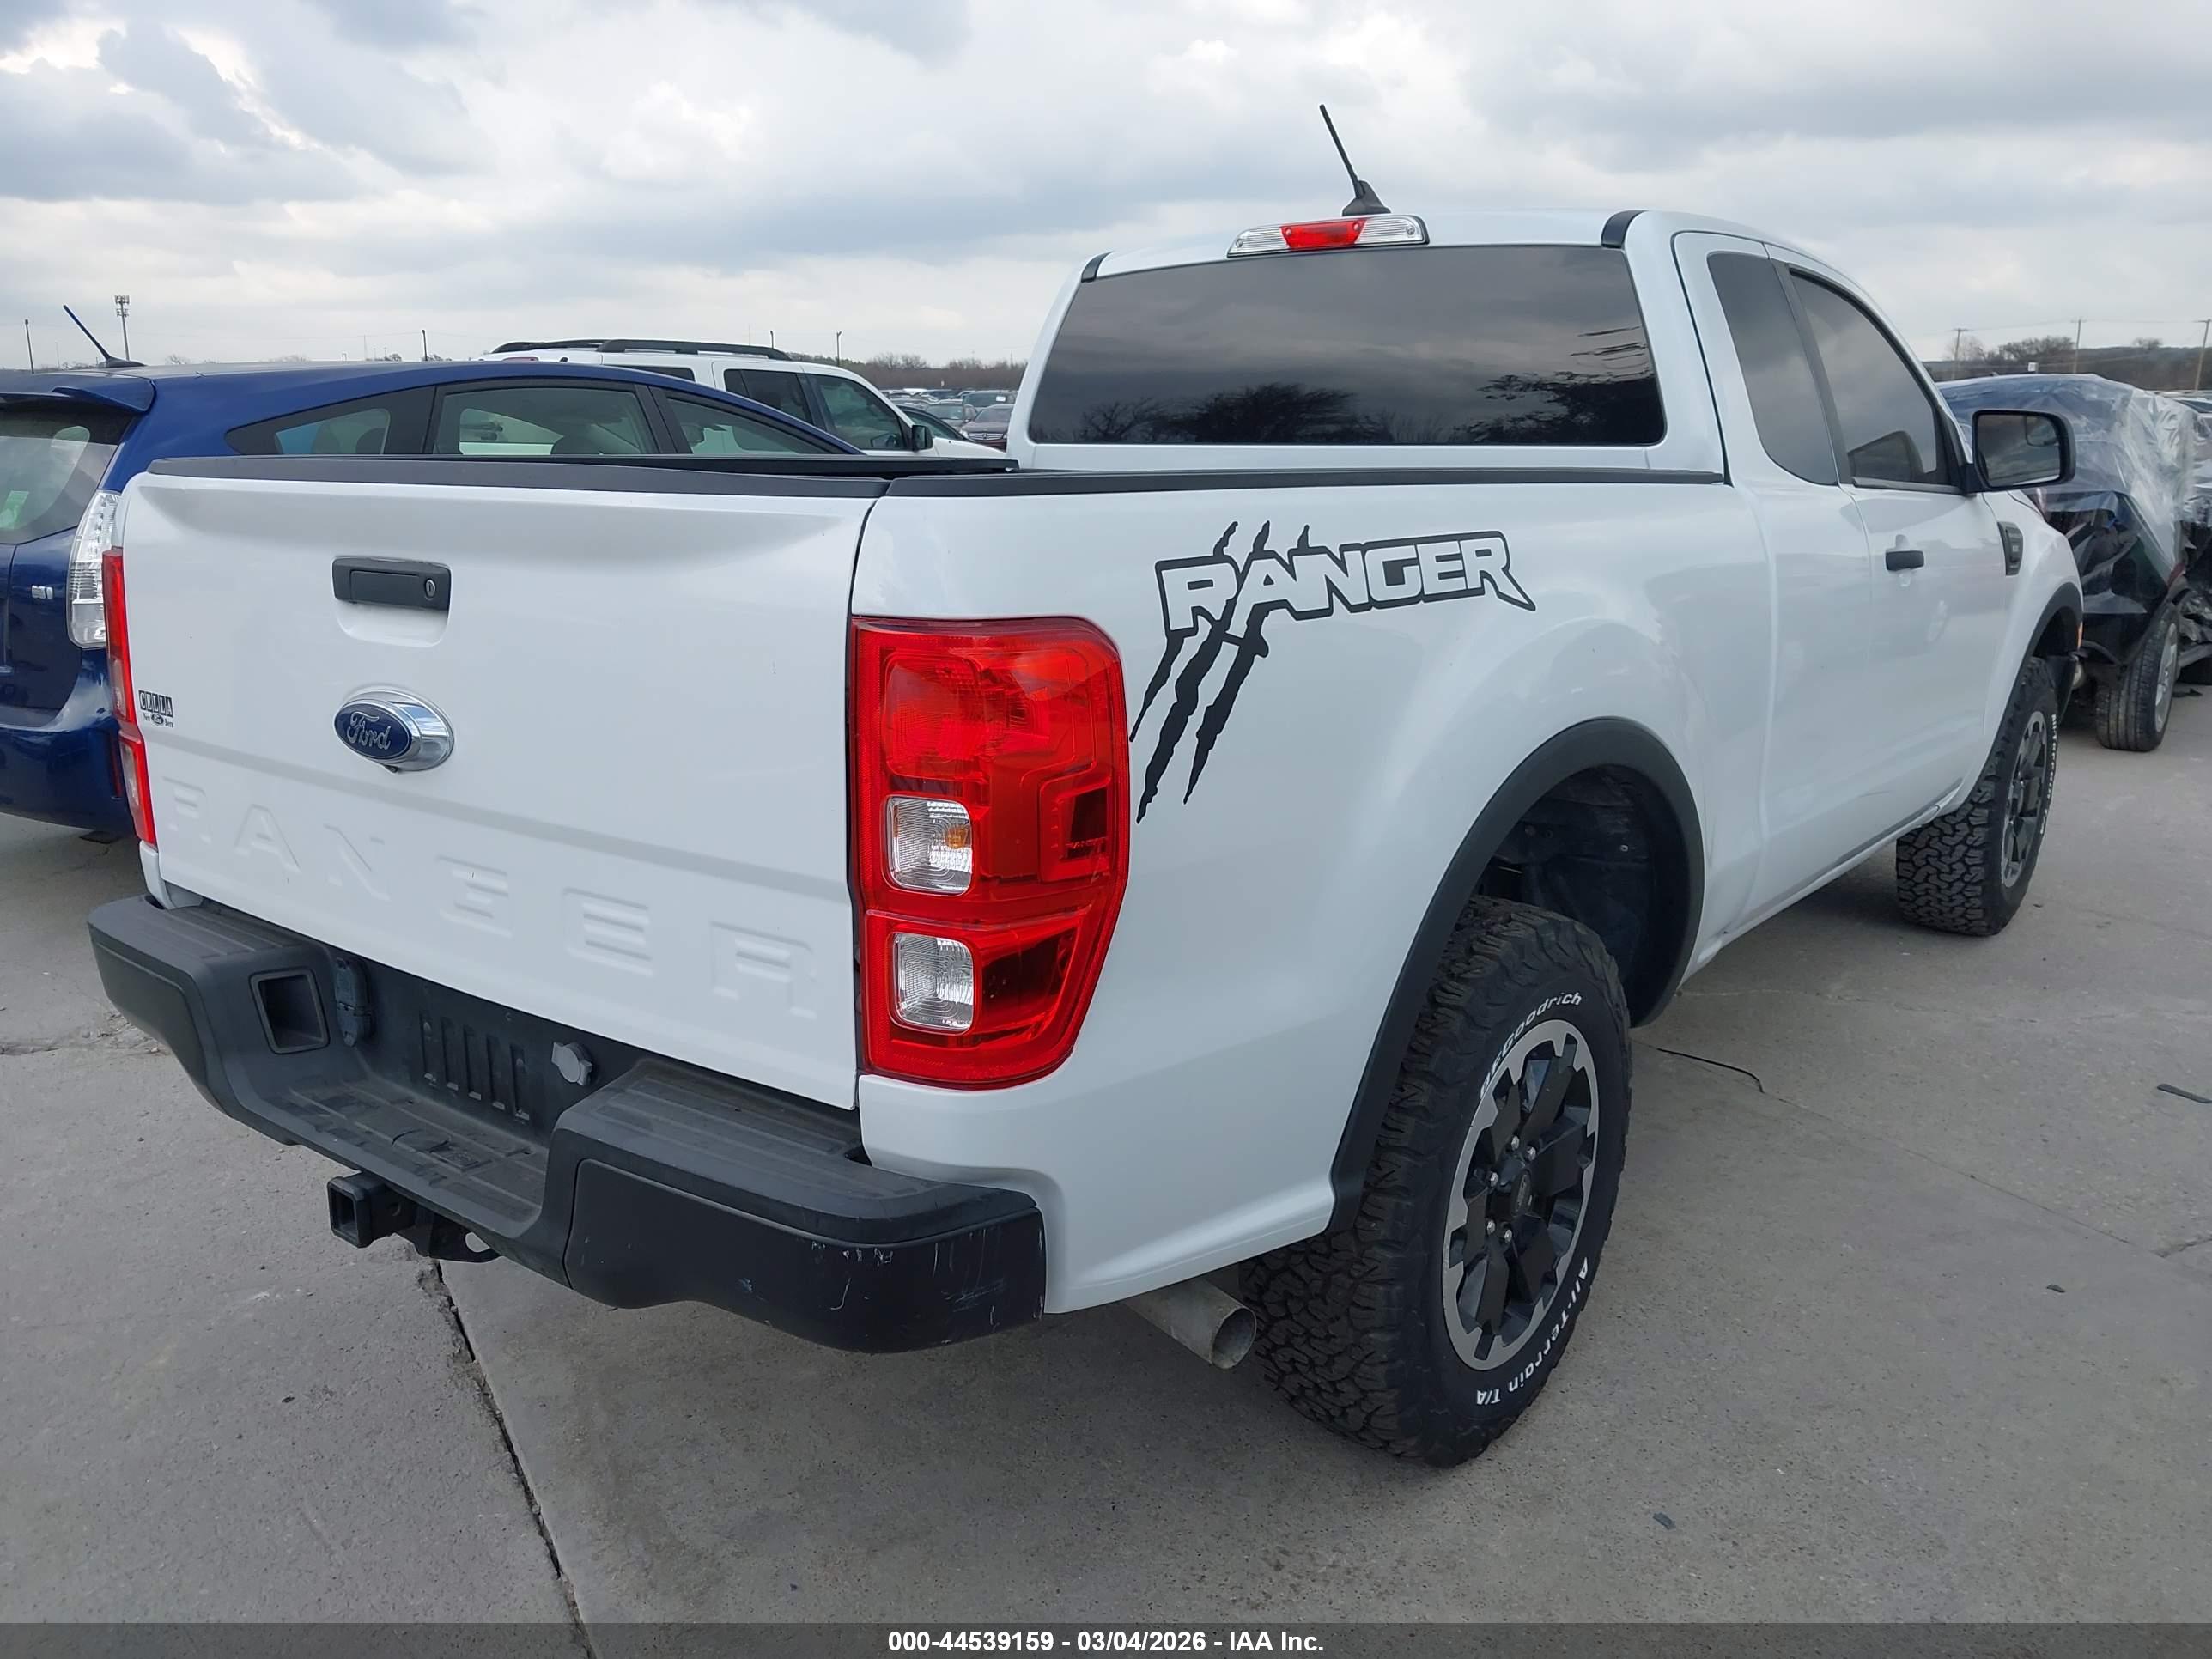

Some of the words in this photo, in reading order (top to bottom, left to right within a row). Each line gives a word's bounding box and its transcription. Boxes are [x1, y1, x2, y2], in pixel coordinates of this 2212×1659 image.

[1156, 531, 1536, 639] RANGER
[138, 690, 173, 718] CELLA
[347, 711, 392, 750] Ford
[1507, 1256, 1589, 1393] All-Terrain
[1475, 1388, 1501, 1406] T/A
